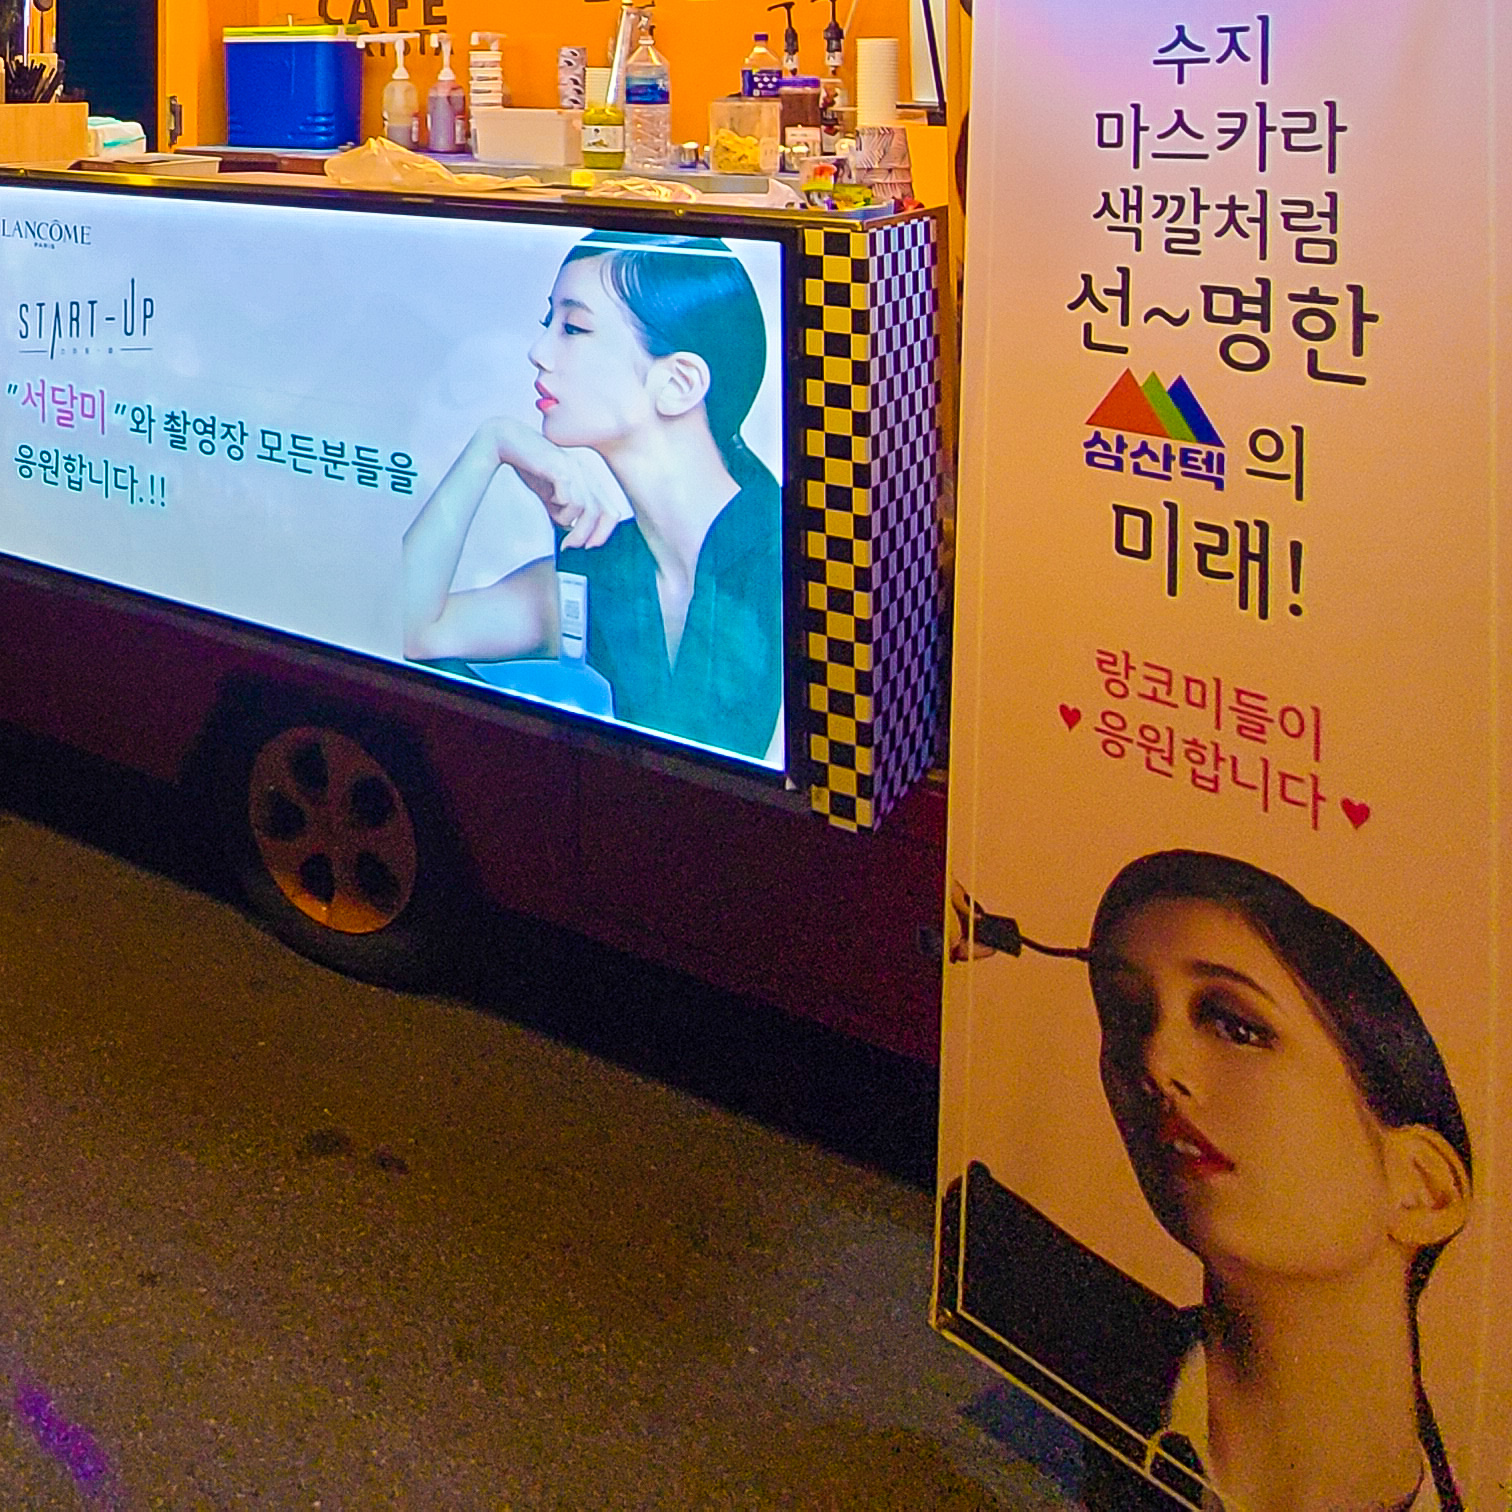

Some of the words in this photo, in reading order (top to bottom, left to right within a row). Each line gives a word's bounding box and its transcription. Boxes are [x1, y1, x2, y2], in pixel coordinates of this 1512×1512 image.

[1153, 15, 1270, 85] 수지
[1095, 101, 1347, 174] 마스카라
[1, 218, 91, 245] LANCÔME
[1092, 186, 1338, 265] 색깔처럼
[19, 277, 154, 360] START-UP
[1067, 267, 1379, 386] 선~명한
[14, 444, 167, 506] 응원합니다.!!
[163, 409, 248, 462] 촬영장
[257, 428, 418, 495] 모든분들을
[1083, 430, 1226, 492] 삼산텍
[1245, 425, 1304, 501] 의
[1112, 500, 1304, 620] 미래!
[1096, 649, 1321, 762] 랑코미들이
[1094, 709, 1327, 831] 응원합니다
